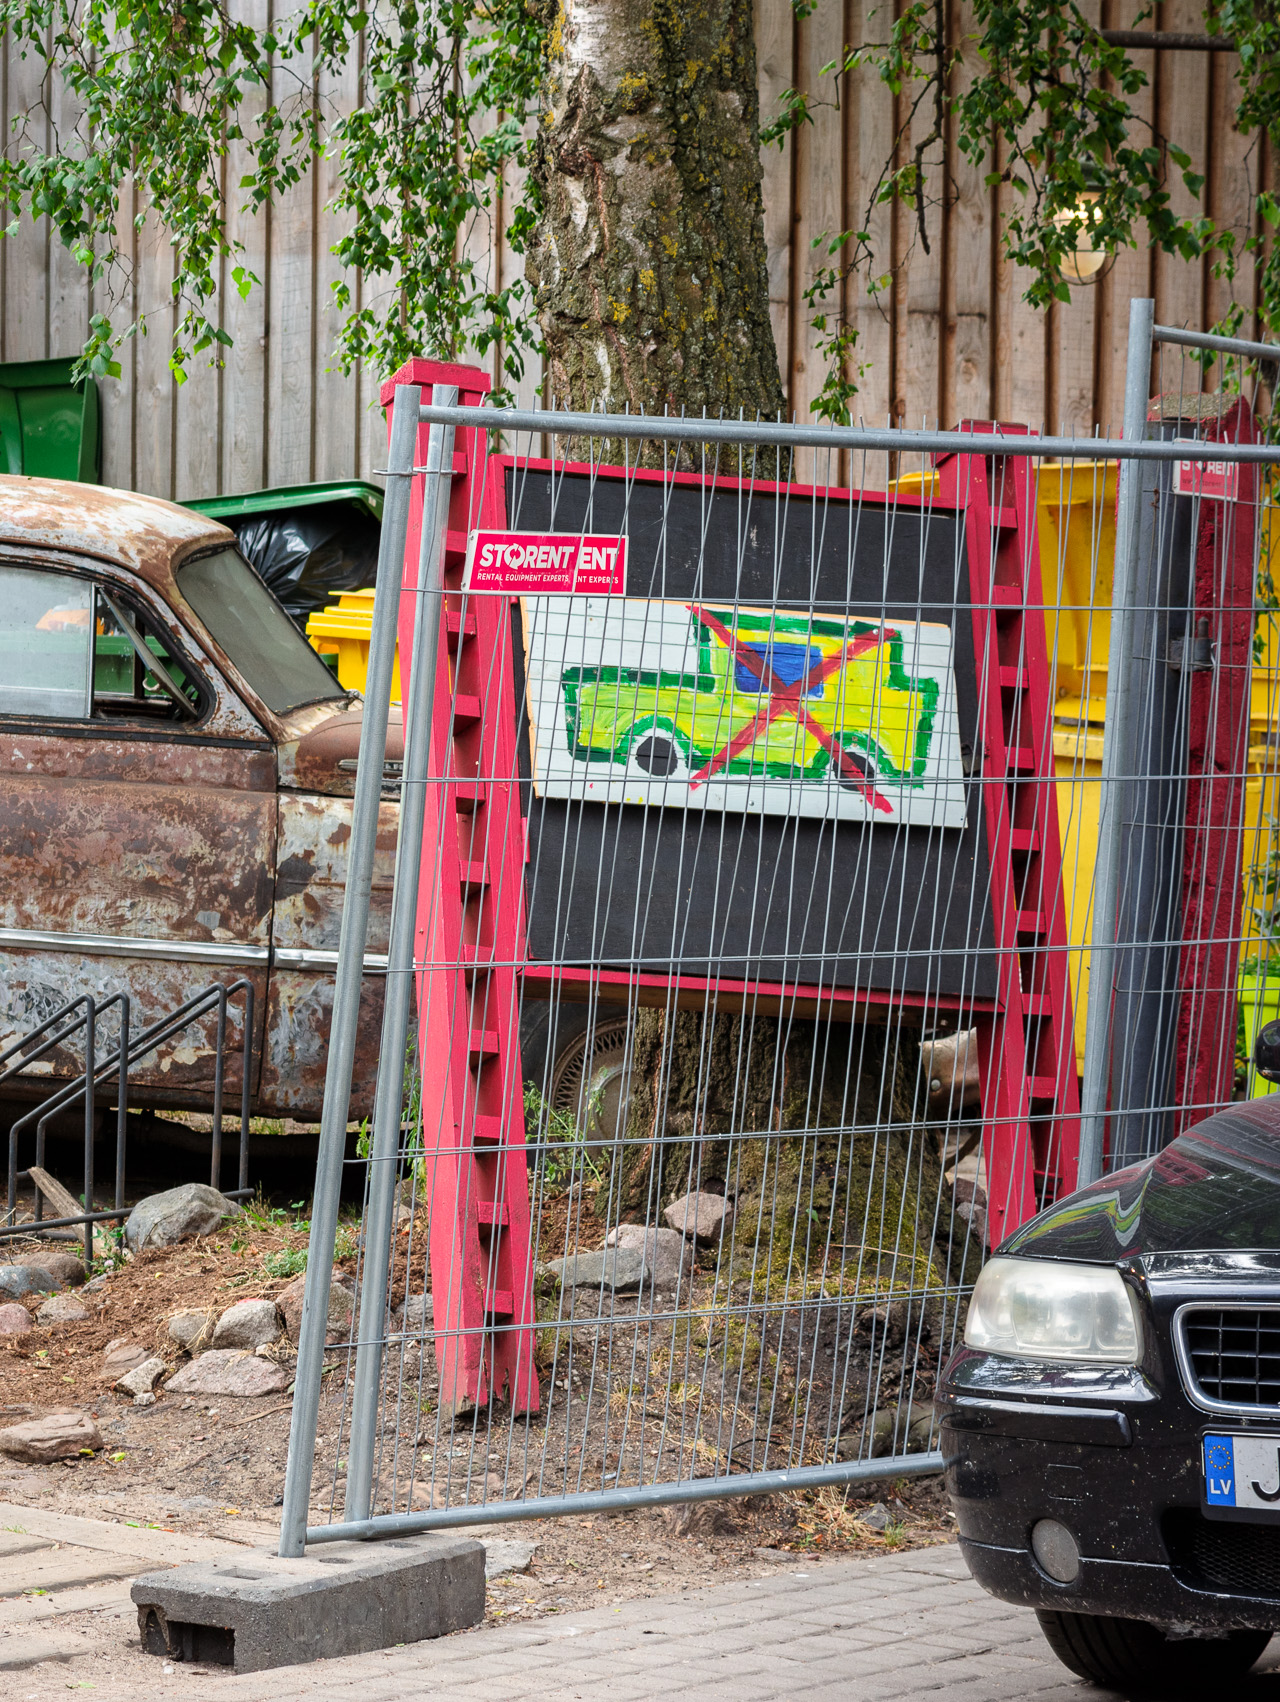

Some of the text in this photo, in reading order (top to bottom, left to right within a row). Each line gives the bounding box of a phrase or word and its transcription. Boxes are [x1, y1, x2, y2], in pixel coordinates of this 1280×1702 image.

[479, 543, 575, 570] STORENT
[477, 573, 569, 583] RENTAL EQUIPMENT EXPERTS
[1210, 1478, 1232, 1495] LV
